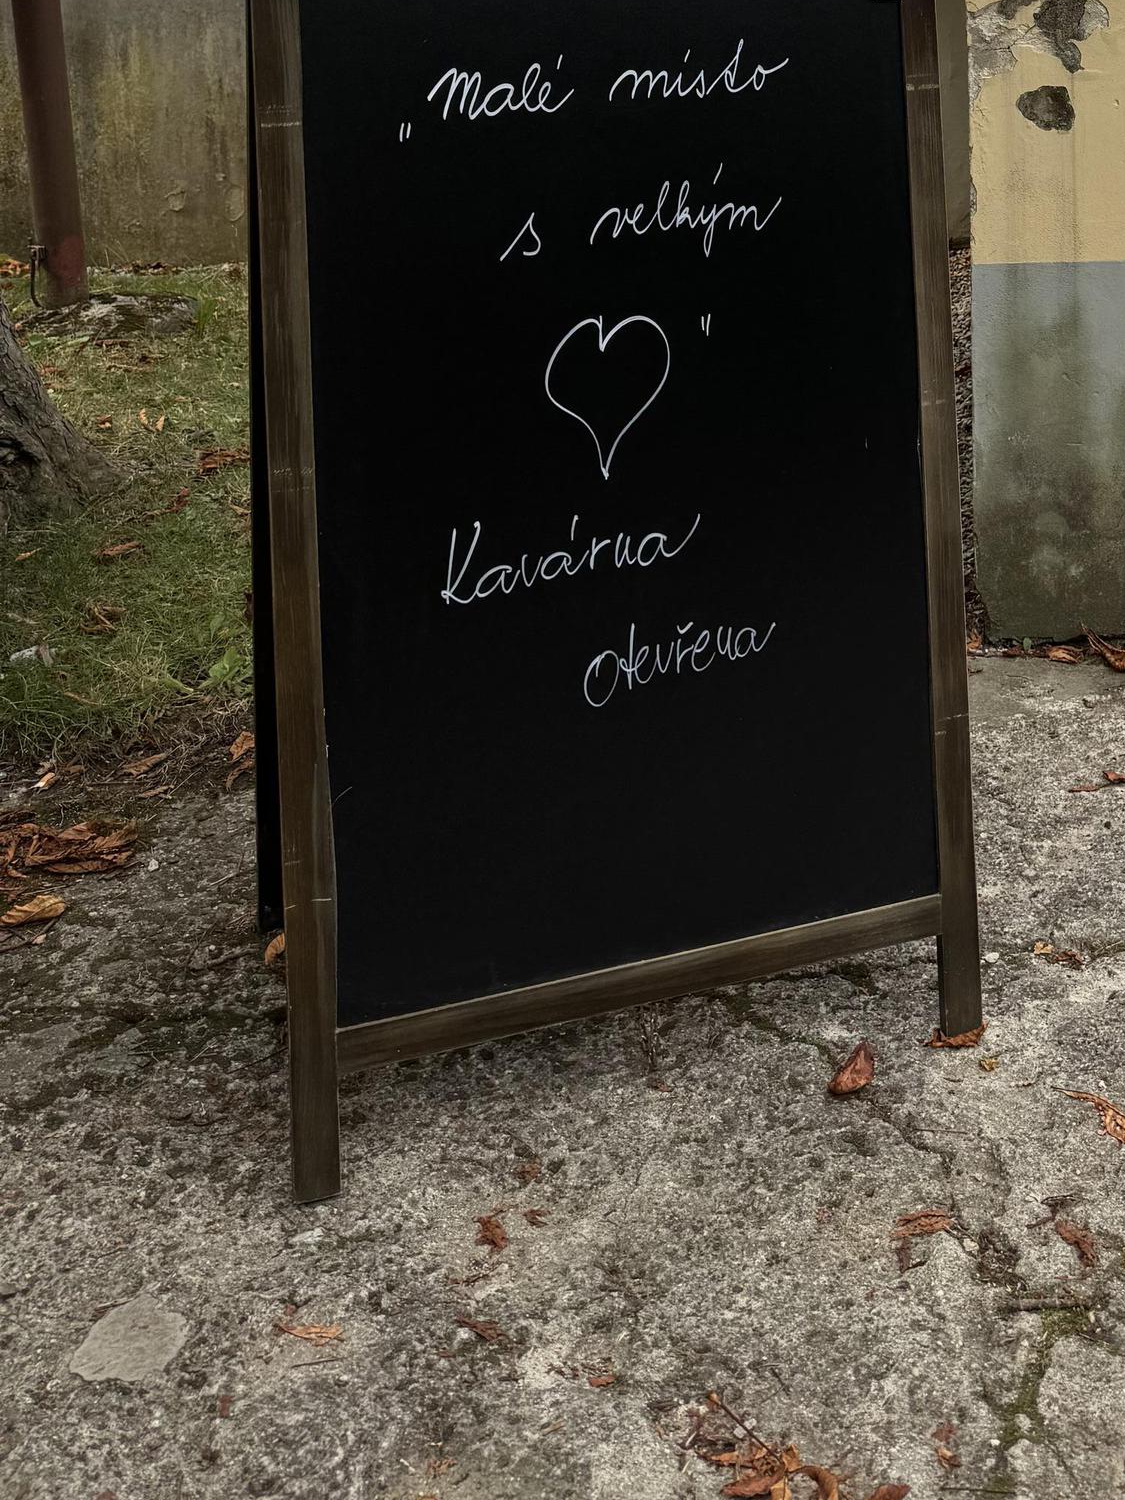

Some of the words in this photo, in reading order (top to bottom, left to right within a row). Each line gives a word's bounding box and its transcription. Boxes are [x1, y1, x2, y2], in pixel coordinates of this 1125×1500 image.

[608, 38, 790, 102] místo
[589, 162, 783, 258] velkým
[440, 513, 701, 605] Kavárna
